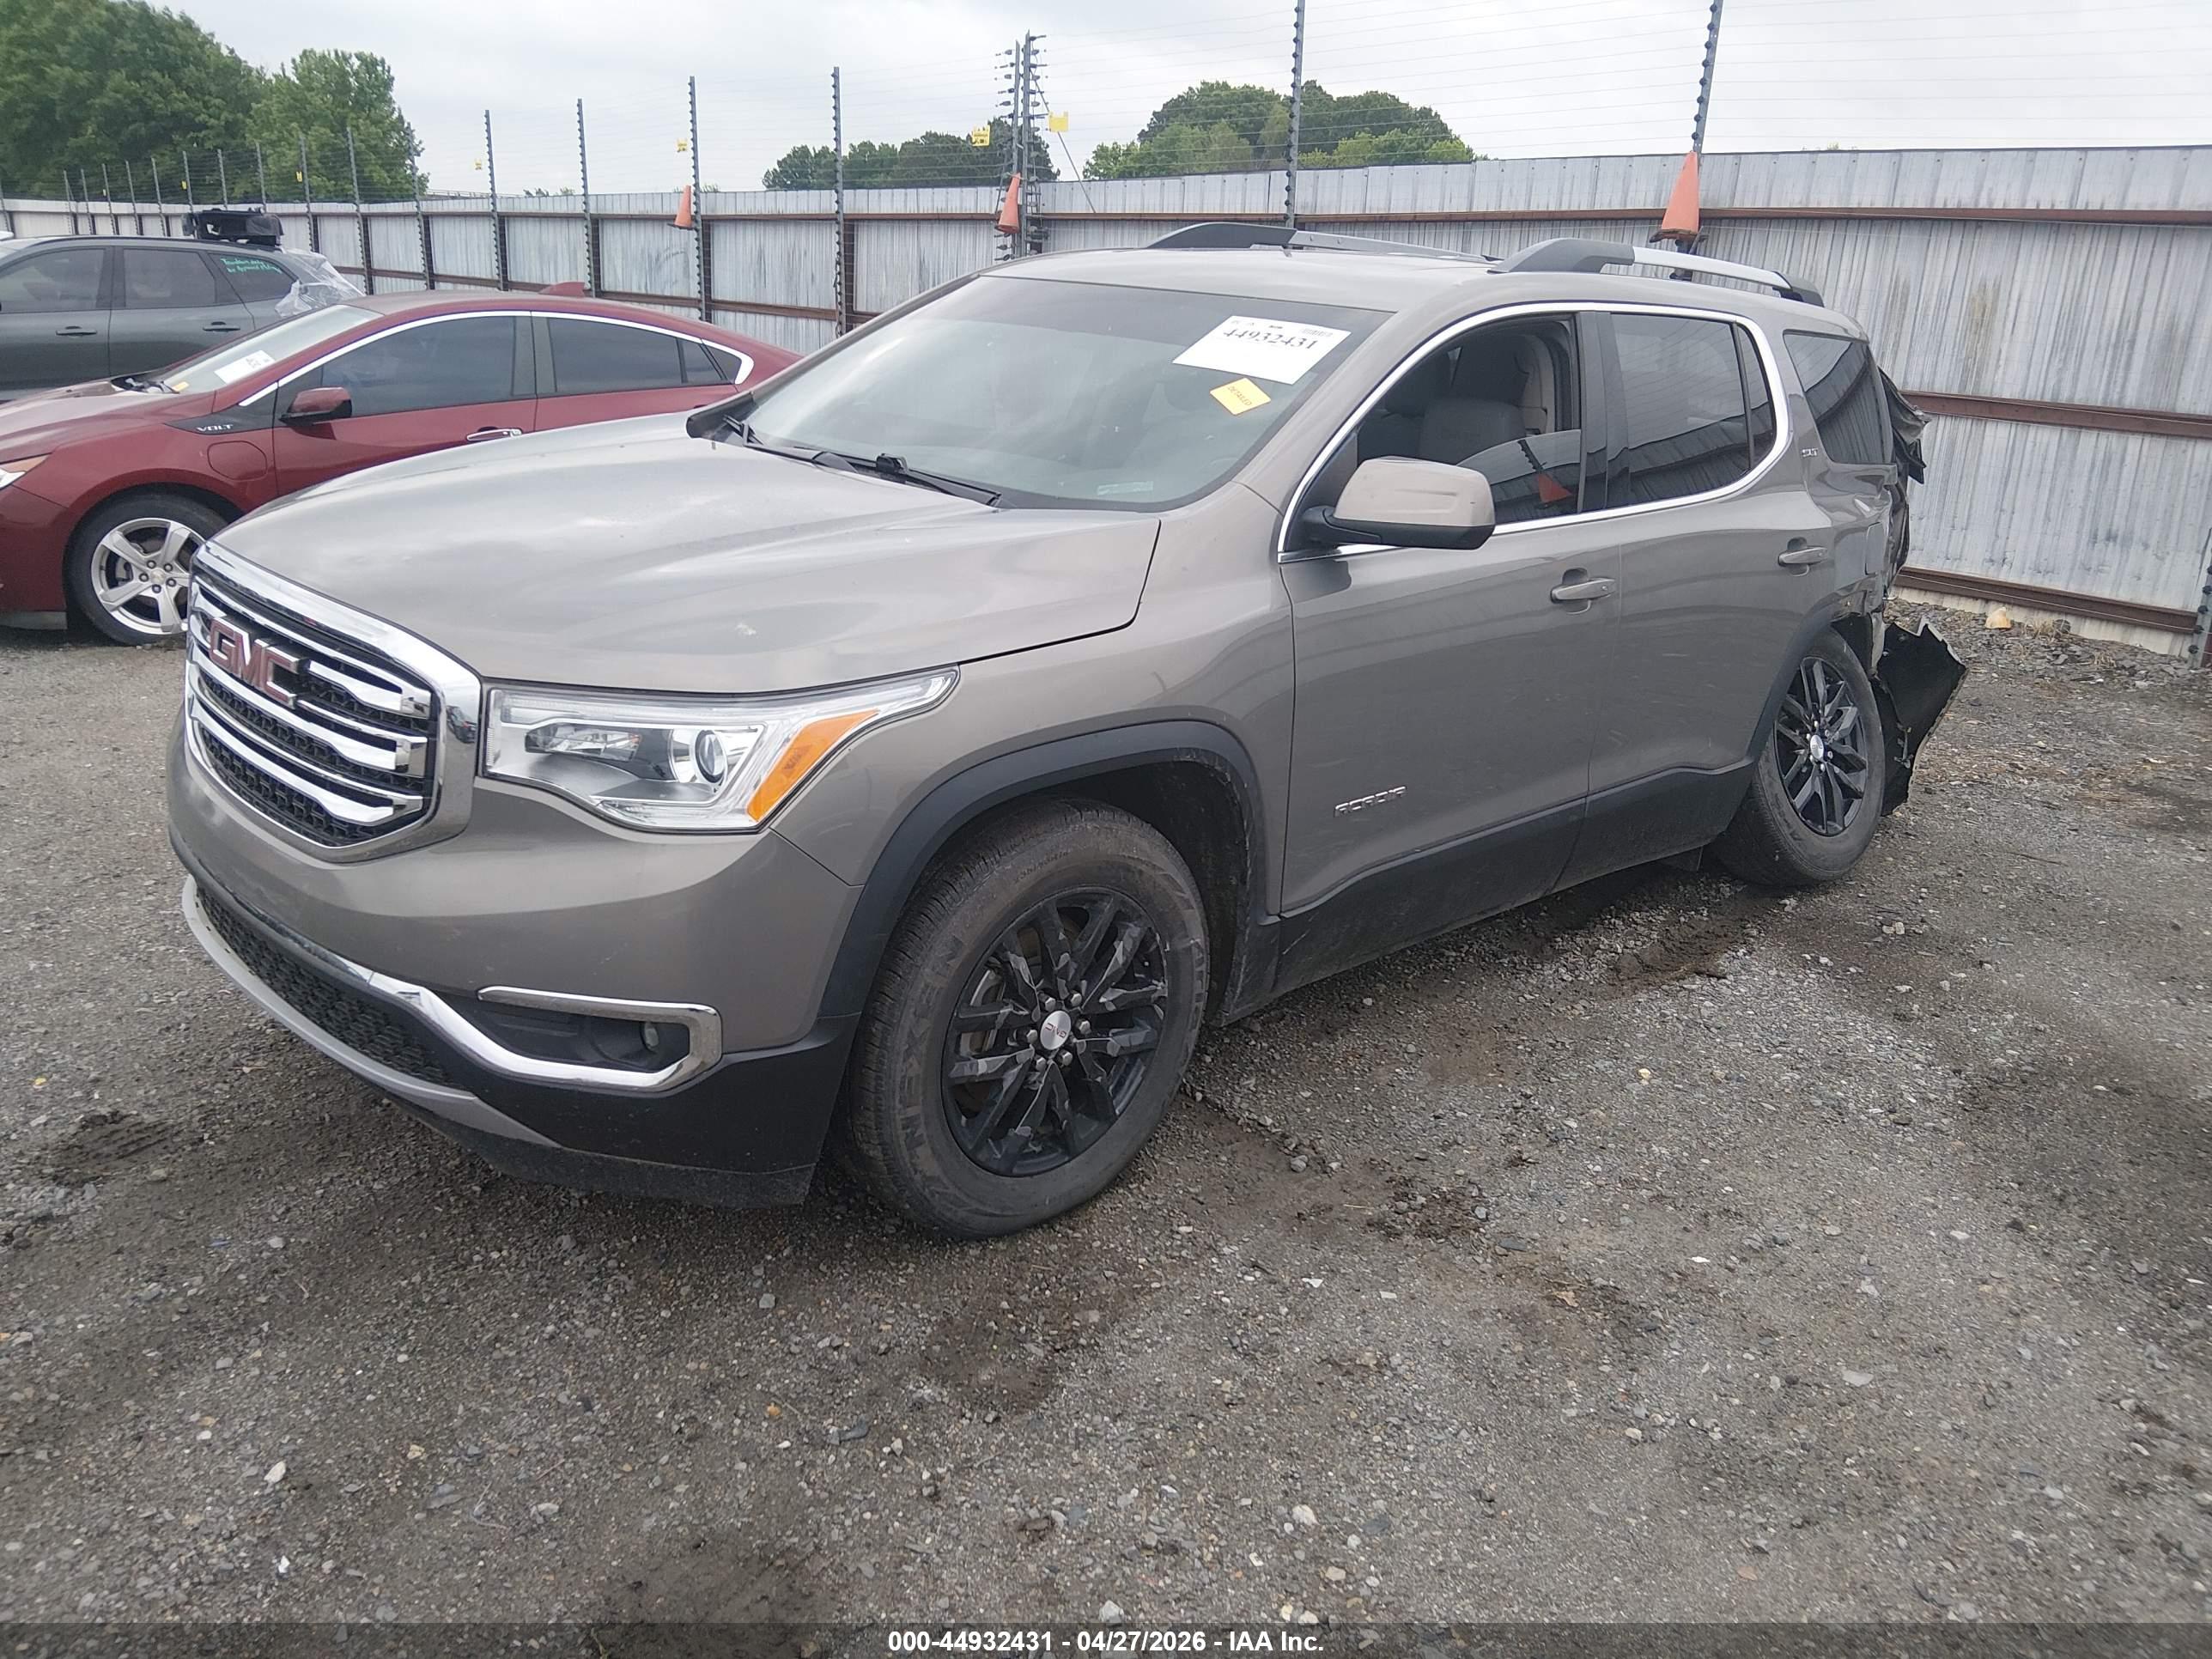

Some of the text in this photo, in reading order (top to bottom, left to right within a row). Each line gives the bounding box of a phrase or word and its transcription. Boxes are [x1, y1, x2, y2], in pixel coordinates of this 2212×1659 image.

[1223, 328, 1318, 349] 44932431
[196, 423, 234, 432] VOLT
[210, 617, 301, 709] GMC
